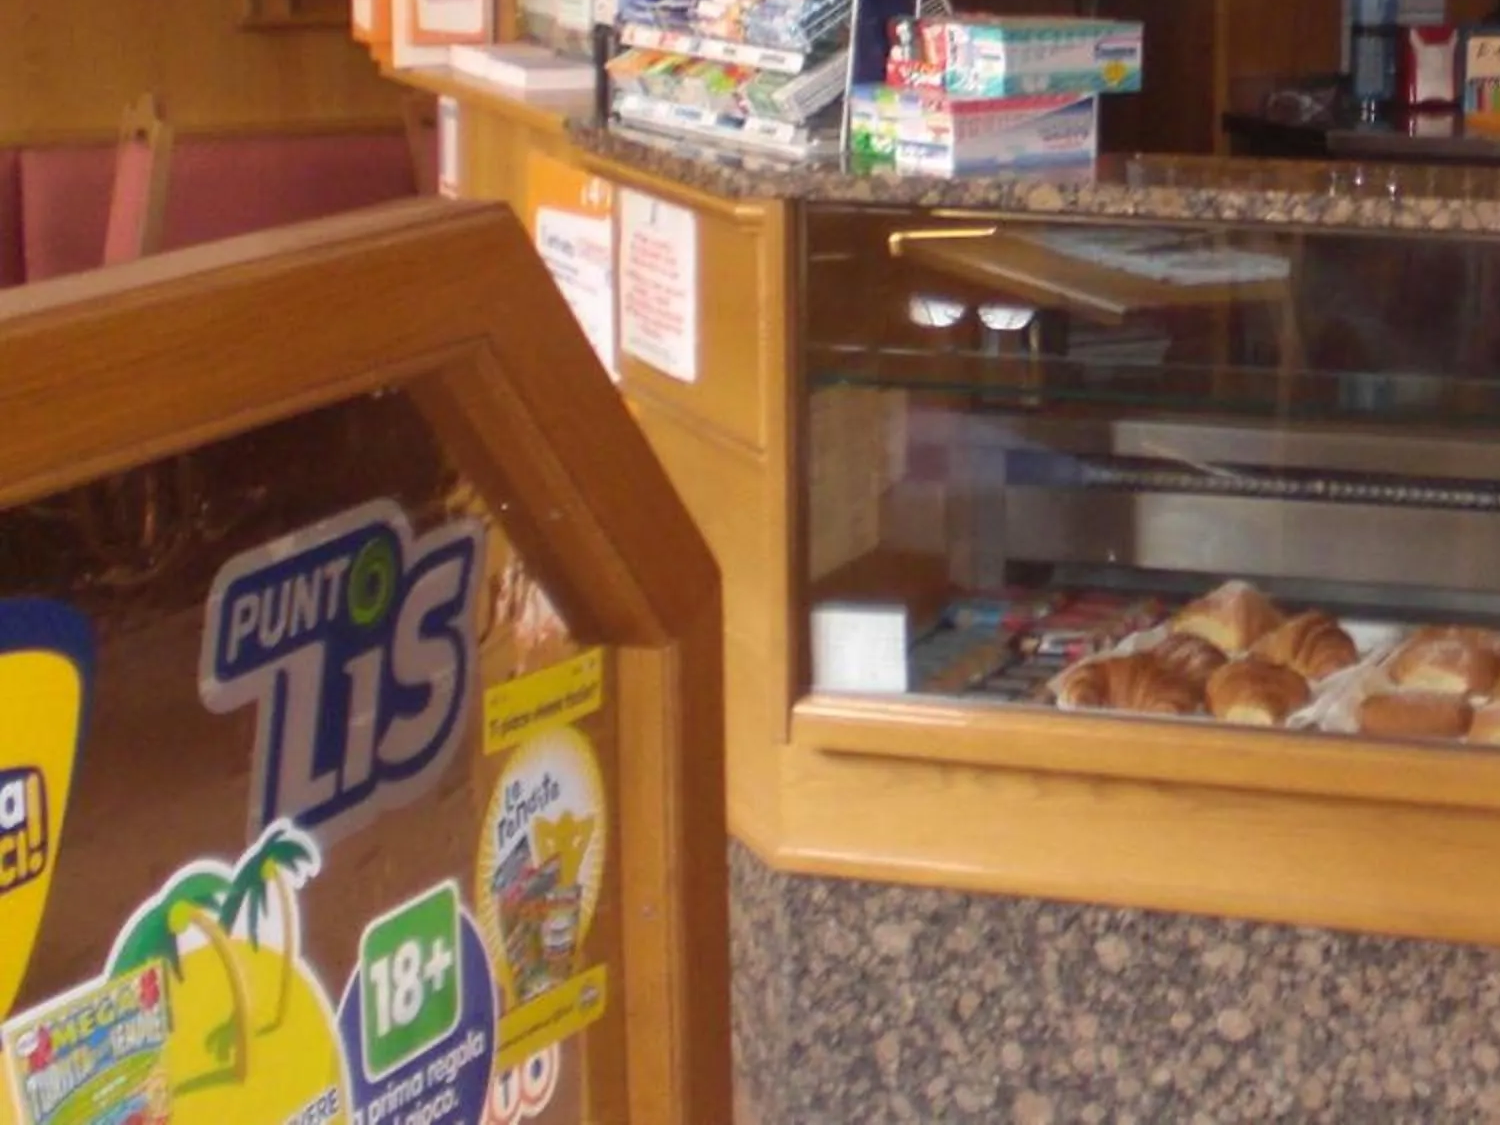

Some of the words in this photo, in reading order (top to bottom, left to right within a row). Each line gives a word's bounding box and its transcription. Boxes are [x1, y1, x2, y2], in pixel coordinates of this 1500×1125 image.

[225, 536, 396, 665] PUNTO
[370, 937, 453, 1038] 18+
[368, 1072, 423, 1125] prima
[427, 1030, 486, 1088] regola
